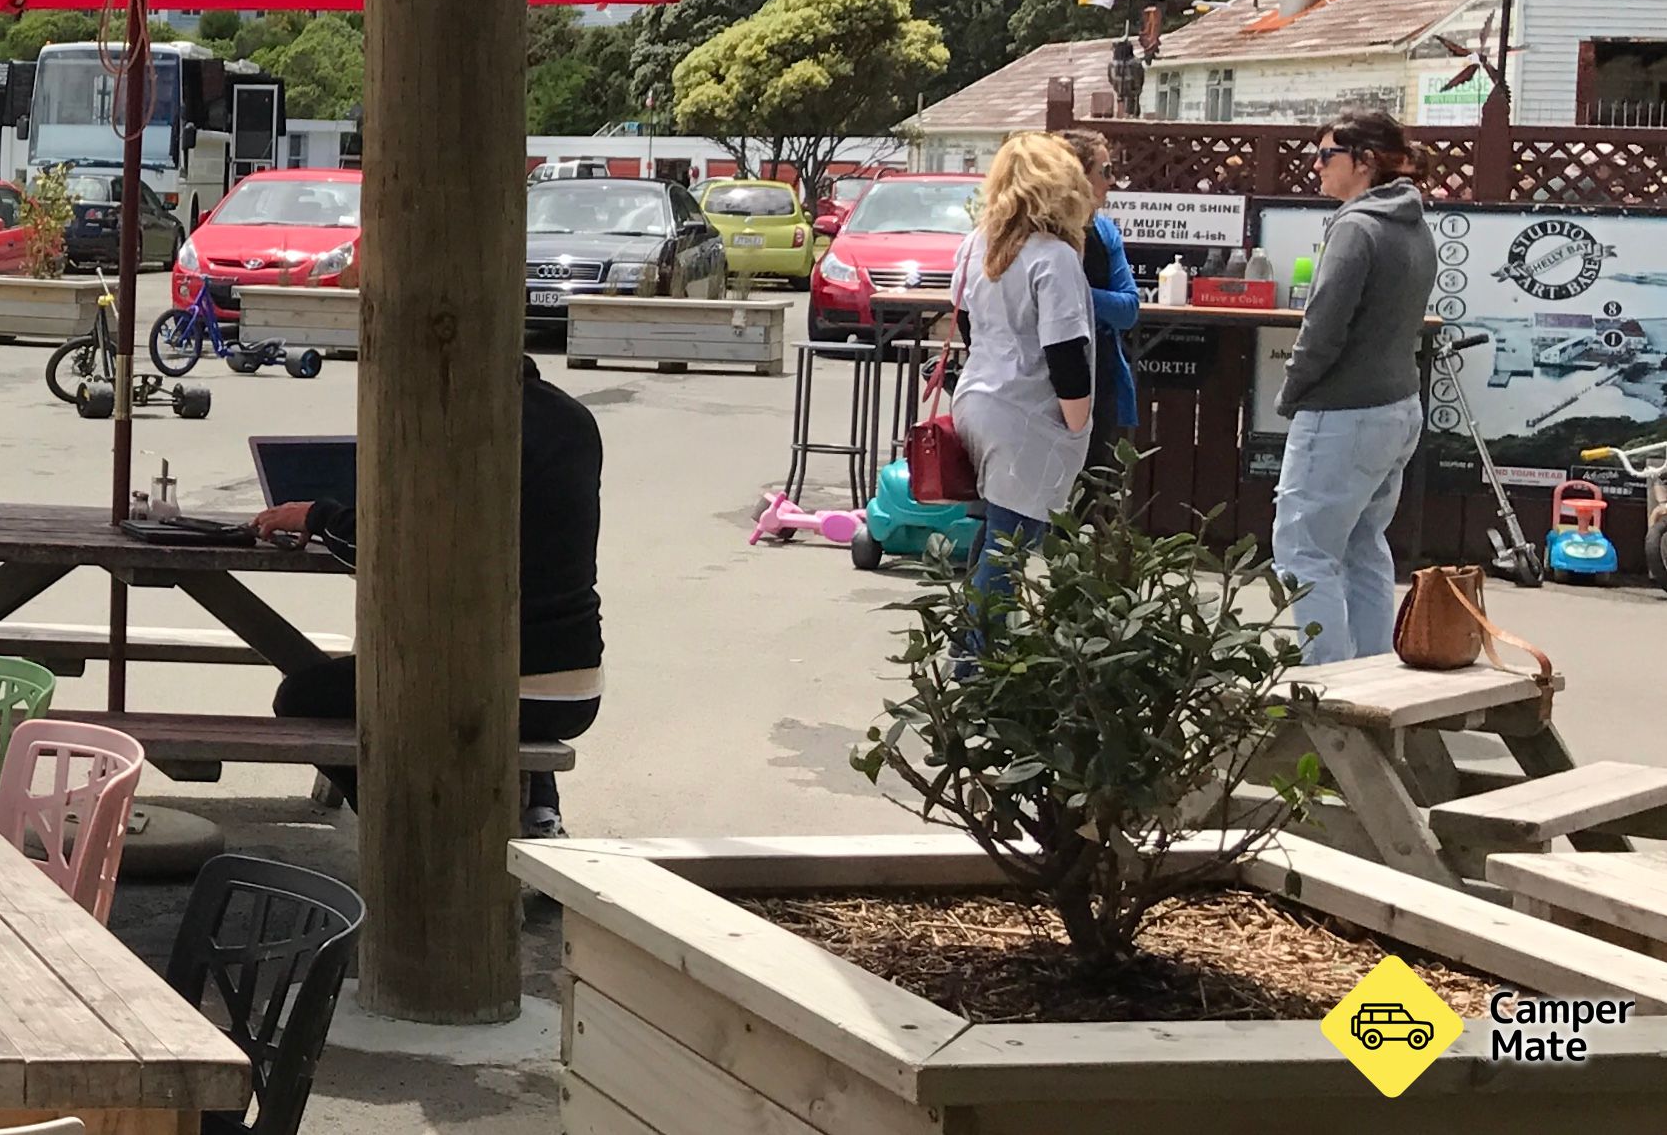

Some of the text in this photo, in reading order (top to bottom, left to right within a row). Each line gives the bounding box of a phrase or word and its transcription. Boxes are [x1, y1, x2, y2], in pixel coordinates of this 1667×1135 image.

[1140, 201, 1173, 212] RAIN
[1176, 203, 1196, 213] OR
[1199, 204, 1241, 214] SHINE
[1133, 218, 1187, 229] MUFFIN
[1137, 229, 1166, 239] BBQ
[1171, 230, 1189, 240] till
[1192, 231, 1227, 241] 4-ish
[1512, 221, 1585, 255] STUDIO
[1526, 240, 1591, 273] SHELLY BAY
[1518, 258, 1600, 299] ART BASE
[531, 292, 559, 304] JUE9
[1200, 293, 1227, 303] Have
[1238, 294, 1265, 305] Coke
[1137, 360, 1197, 374] NORTH
[1511, 468, 1536, 478] YOUR
[1537, 471, 1563, 480] HEAD
